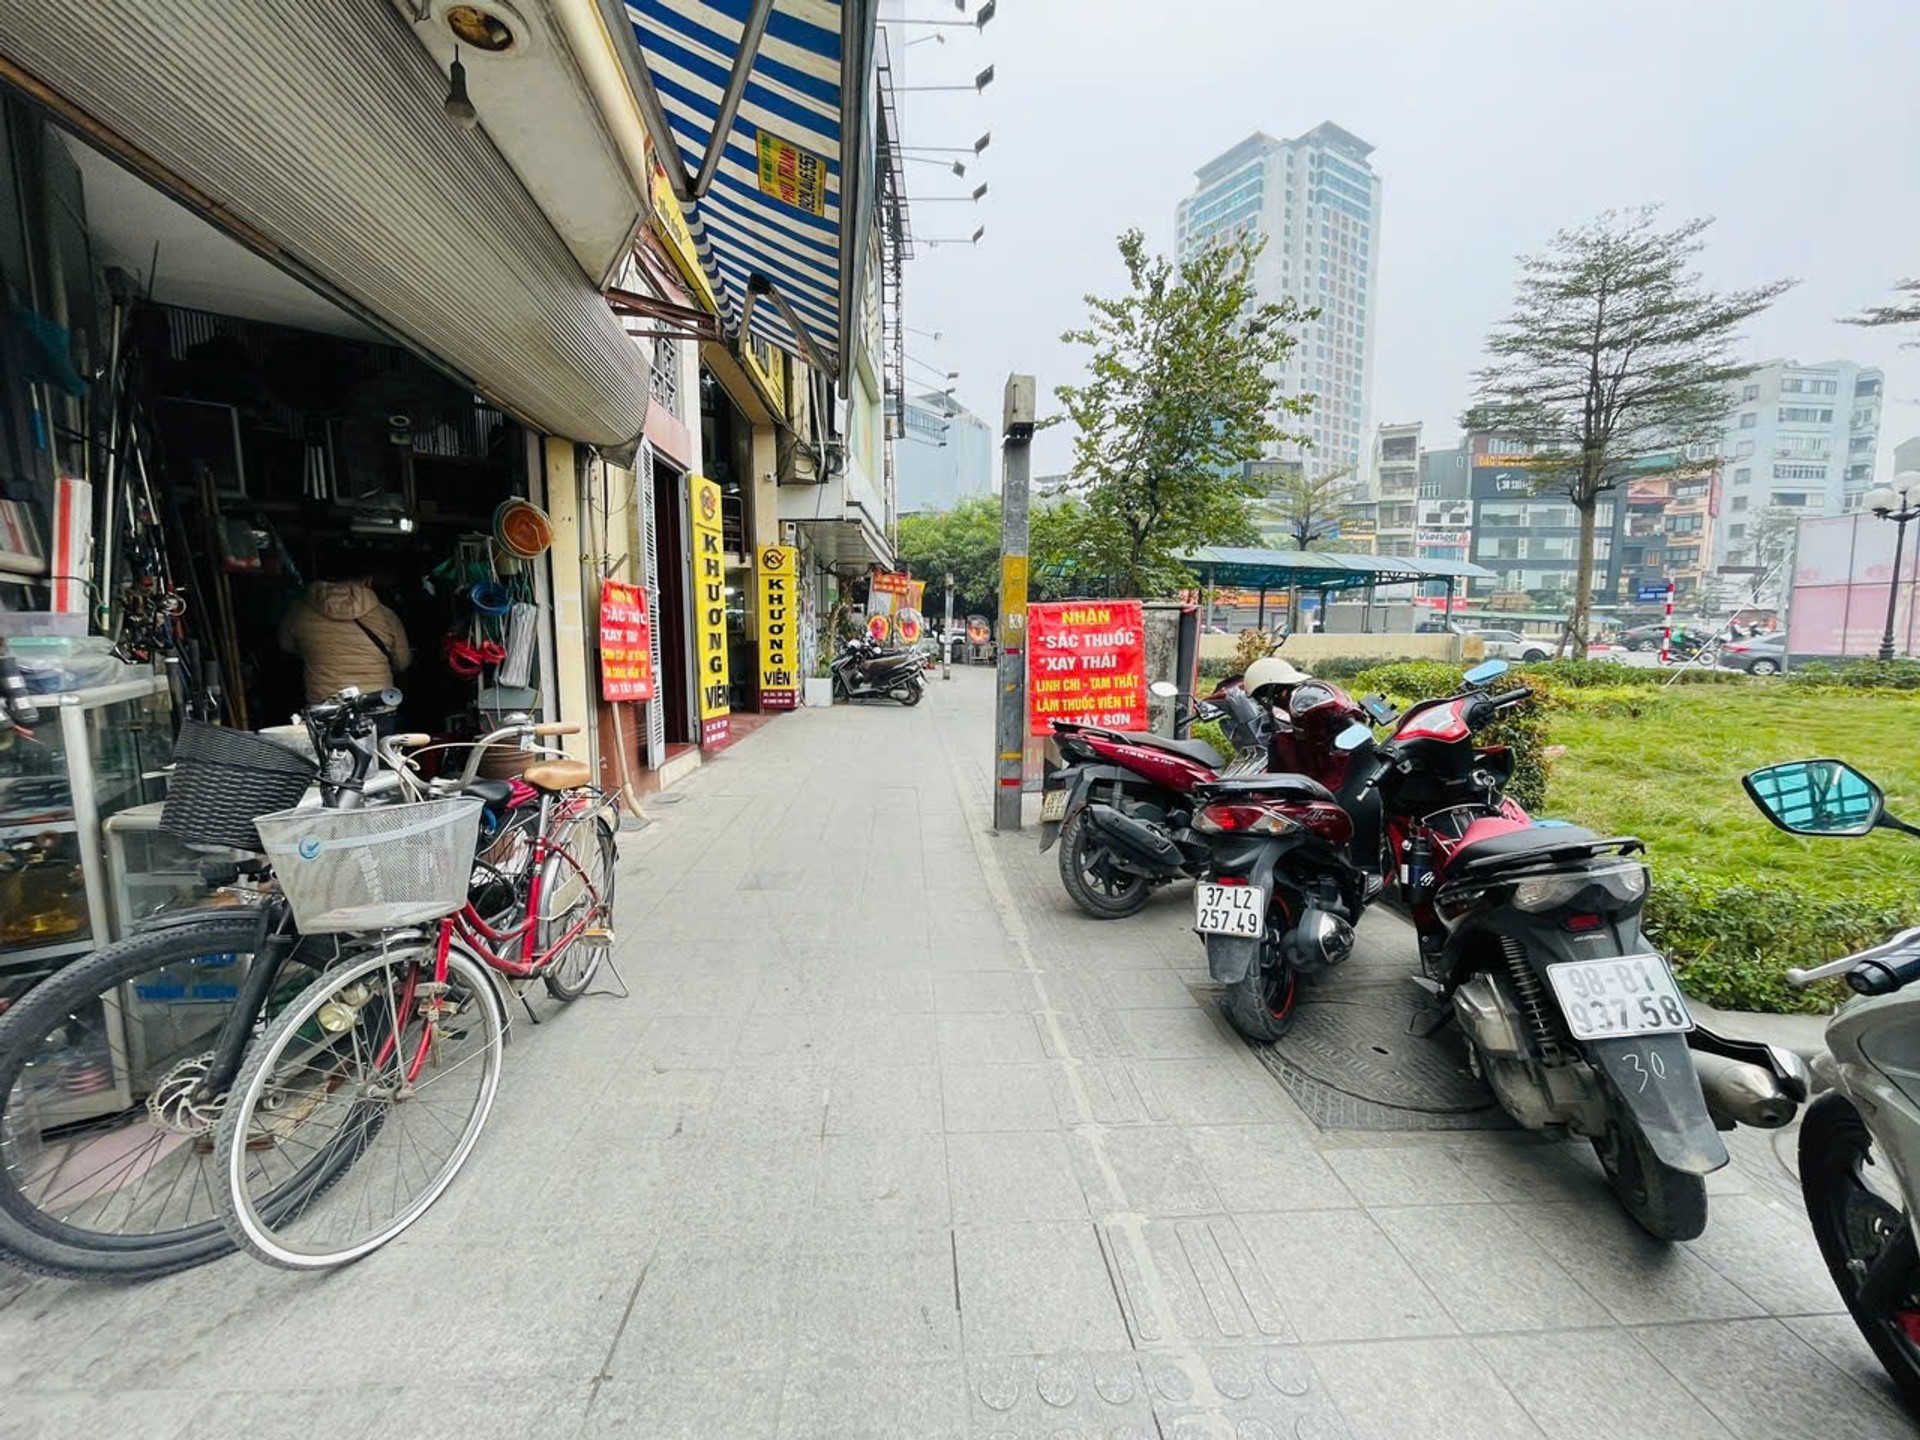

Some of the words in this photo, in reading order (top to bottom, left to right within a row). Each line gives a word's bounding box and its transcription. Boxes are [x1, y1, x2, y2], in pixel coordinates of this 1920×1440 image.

[702, 532, 723, 673] KHƯƠNG
[768, 579, 786, 665] KHƯƠNG
[1084, 628, 1135, 647] THUỐC
[1047, 656, 1076, 671] XAY
[1081, 652, 1117, 669] THÁI
[764, 668, 791, 686] VIÊN
[1037, 679, 1060, 692] LINH
[1063, 678, 1080, 691] CHI
[1090, 676, 1111, 690] TAM
[1103, 713, 1131, 726] SƠN
[1207, 887, 1252, 909] 37-L2
[1200, 909, 1257, 933] 257.49
[1571, 995, 1683, 1033] 937.58
[1622, 1052, 1666, 1093] 30
